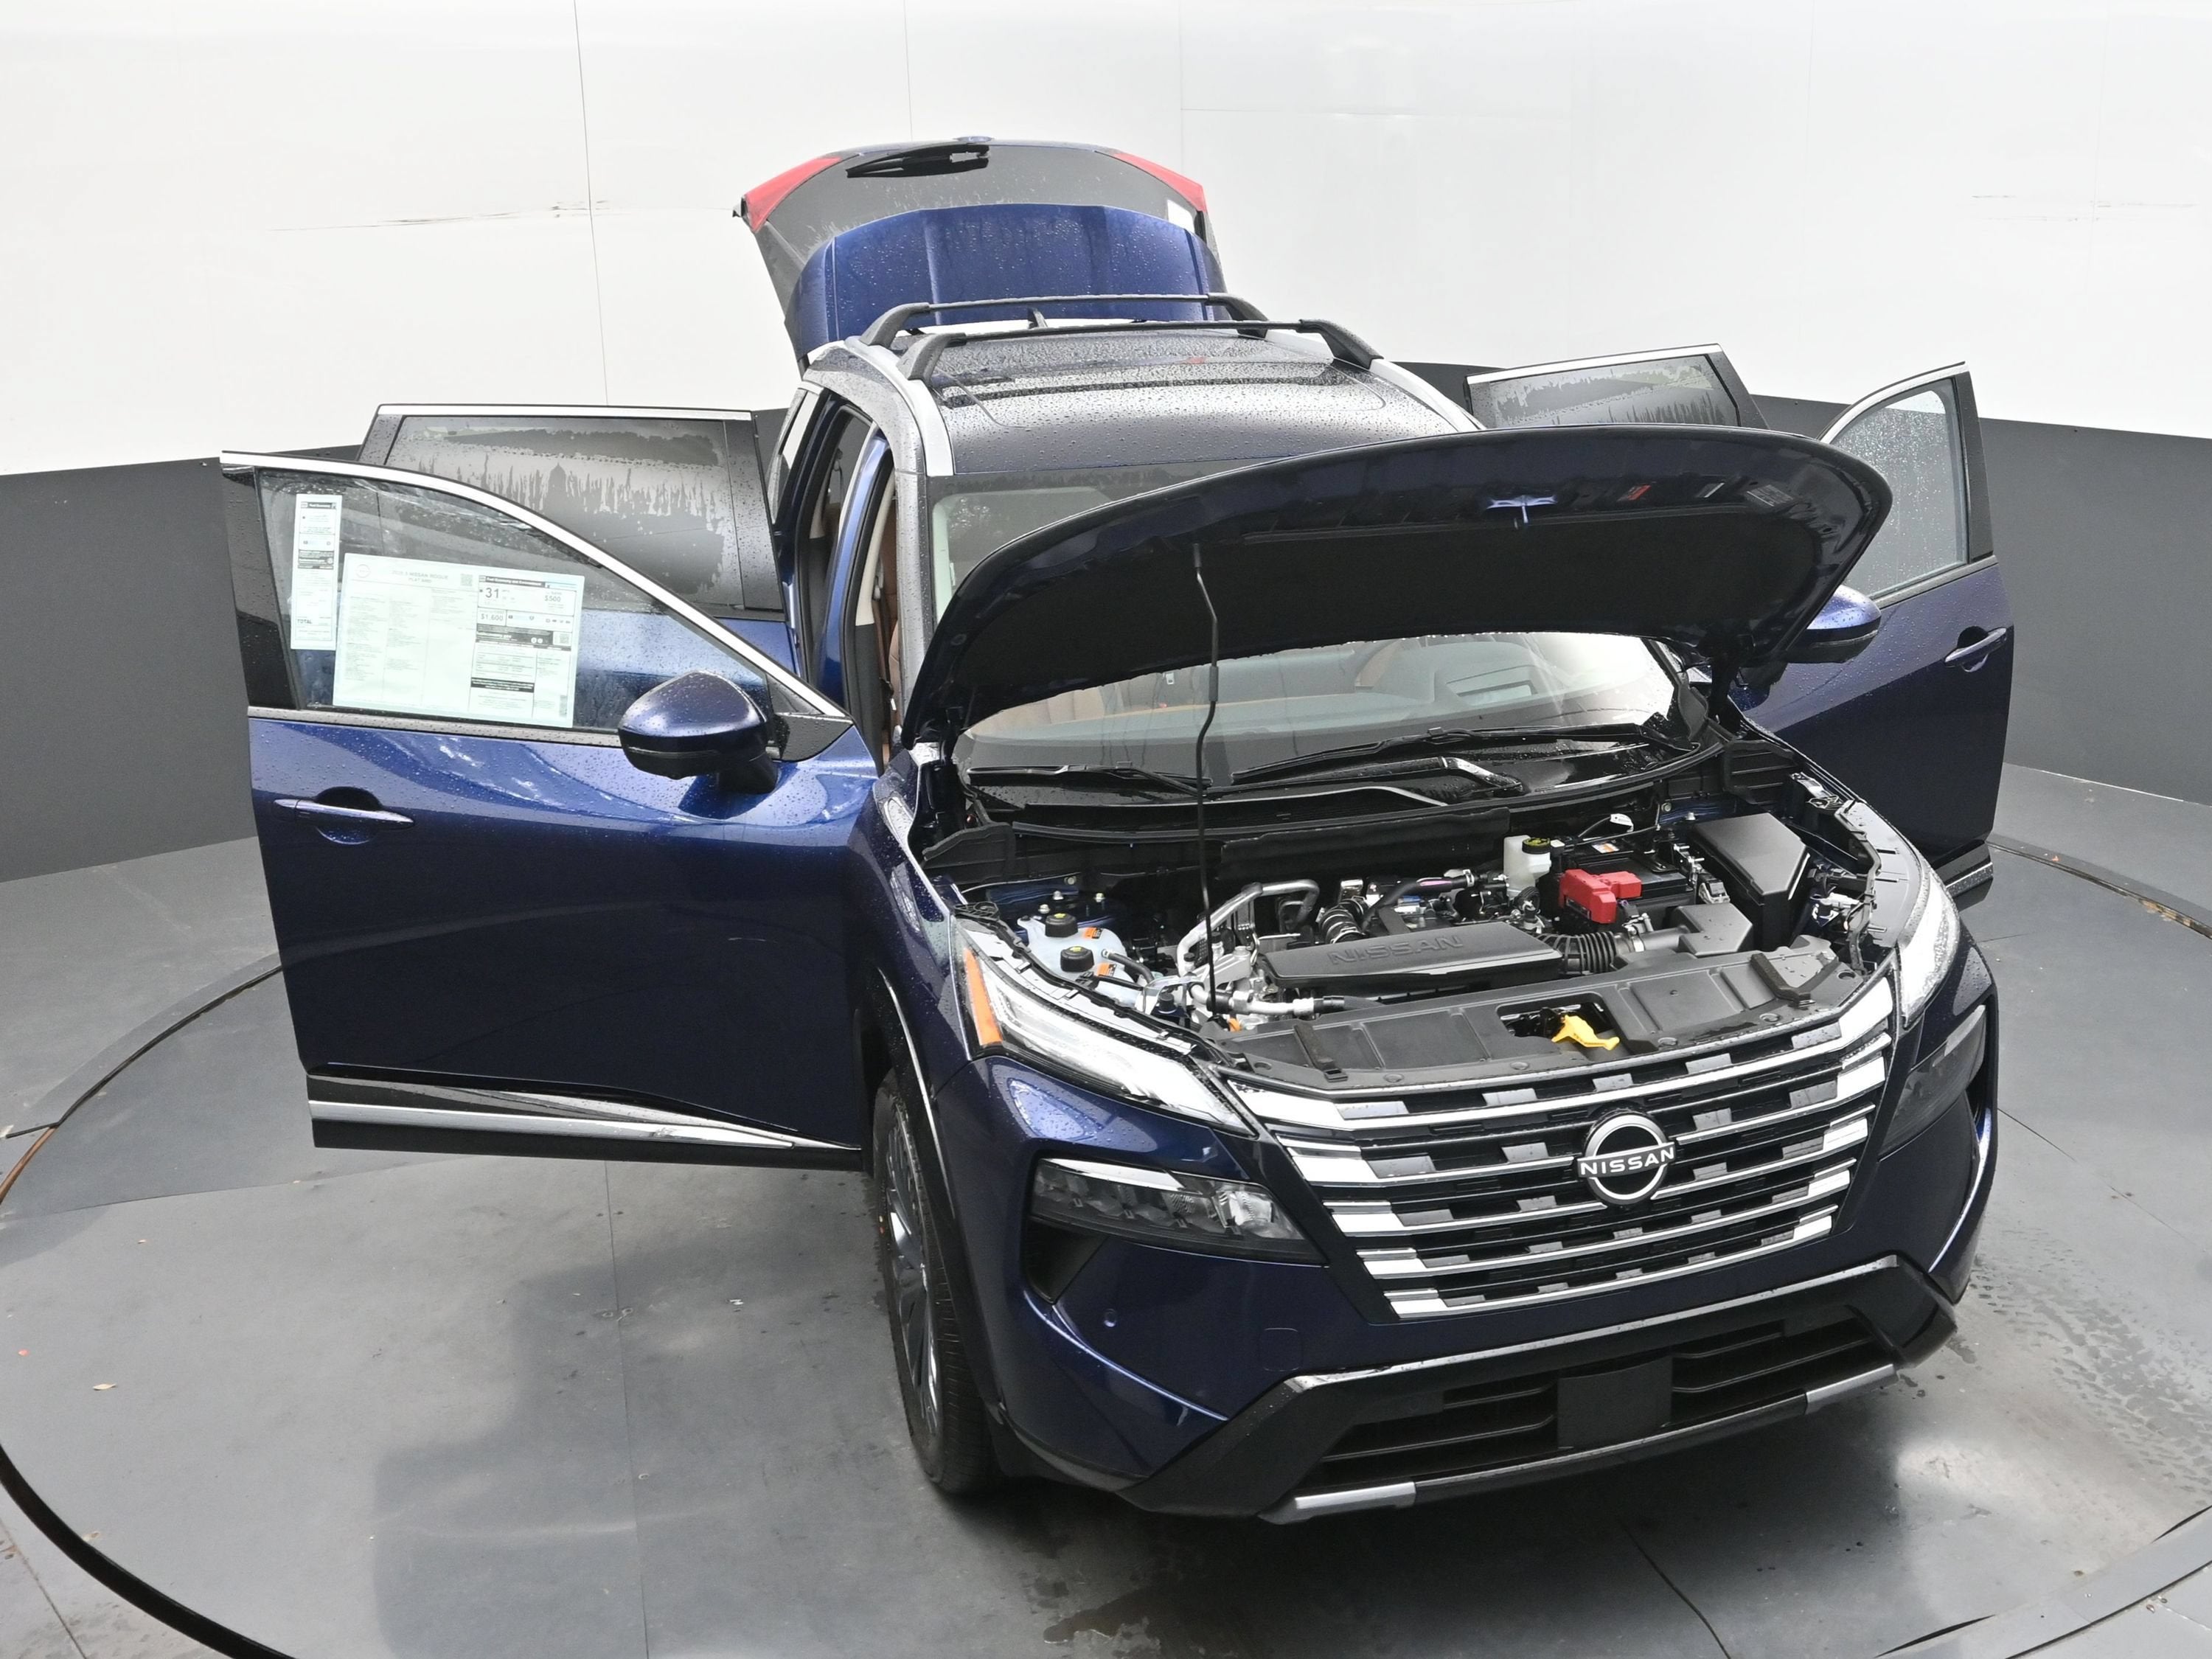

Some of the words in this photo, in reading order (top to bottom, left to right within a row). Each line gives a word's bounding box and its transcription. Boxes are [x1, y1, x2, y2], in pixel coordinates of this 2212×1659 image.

[485, 587, 499, 599] 31
[1328, 934, 1464, 965] NISSAN
[1580, 1147, 1674, 1175] NISSAN
